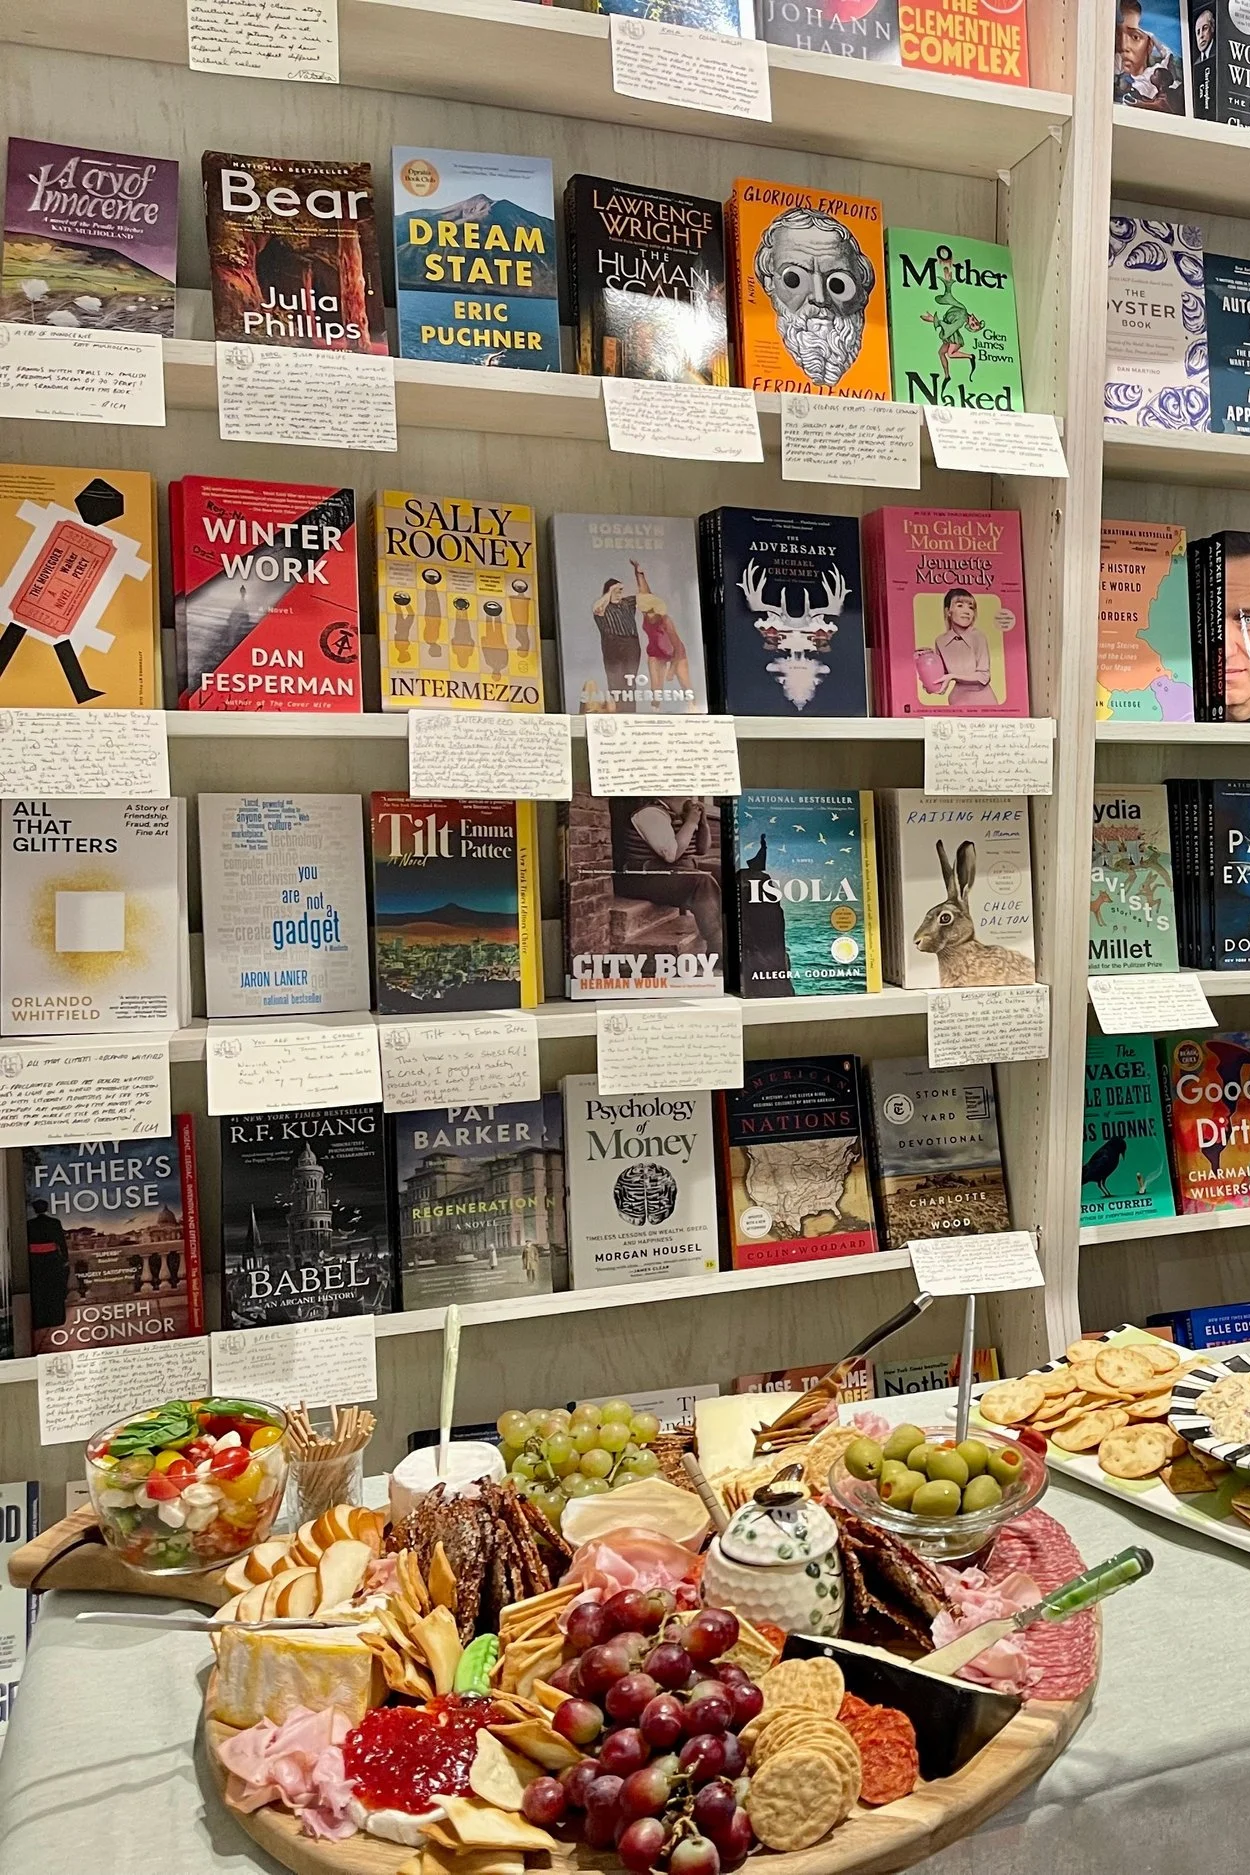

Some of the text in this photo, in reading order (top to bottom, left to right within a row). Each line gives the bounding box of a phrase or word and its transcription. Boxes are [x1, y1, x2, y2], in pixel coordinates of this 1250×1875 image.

[900, 33, 1021, 77] COMPLEX
[1228, 97, 1246, 108] THE
[57, 157, 80, 190] A
[123, 164, 156, 200] of
[233, 161, 348, 175] NATIONAL BESTSELLER
[27, 163, 159, 224] Innocence
[221, 169, 367, 219] Bear
[593, 190, 713, 230] LAWRENCE
[51, 225, 133, 240] KATE MULHOLLAND
[408, 218, 545, 254] DREAM
[425, 254, 532, 287] STATE
[598, 249, 709, 290] HUMAN
[899, 245, 1008, 290] Mother
[261, 287, 338, 312] Julia
[244, 312, 361, 345] Phillips
[1122, 319, 1151, 329] BOOK
[405, 498, 513, 537] SALLY
[202, 517, 344, 552] WINTER
[588, 523, 664, 537] ROSALYN
[904, 519, 1004, 540] I'm Glad My
[385, 527, 532, 569] ROONEY
[749, 541, 837, 557] ADVERSARY
[910, 535, 997, 552] Mom Died
[221, 553, 330, 585] WORK
[768, 566, 820, 578] CRUMMEY
[917, 555, 993, 571] Jennette
[1107, 564, 1147, 575] HISTORY
[915, 569, 995, 590] McCurdy
[1105, 597, 1113, 605] in
[251, 647, 304, 668] DAN
[201, 672, 354, 697] FESPERMAN
[390, 677, 540, 704] INTERMEZZO
[624, 674, 648, 687] TO
[13, 801, 52, 817] ALL
[135, 805, 158, 813] Story
[748, 795, 853, 804] NATIONAL BESTSELLER
[13, 838, 118, 853] GLITTERS
[378, 812, 454, 858] Tilt
[298, 866, 318, 883] you
[748, 878, 858, 904] ISOLA
[326, 905, 332, 918] a
[983, 900, 1022, 912] CHLOE
[273, 911, 341, 950] gadget
[980, 915, 1030, 927] DALTON
[235, 923, 271, 943] create
[240, 970, 308, 989] JARON LANIER
[751, 968, 860, 980] ALLEGRA GOODMAN
[11, 996, 92, 1008] ORLANDO
[12, 1010, 100, 1021] WHITFIELD
[916, 1088, 957, 1099] STONE
[1106, 1084, 1152, 1106] DEATH
[585, 1098, 696, 1124] Psychology
[741, 1112, 850, 1134] NATIONS
[1196, 1117, 1249, 1148] Dirt
[414, 1123, 531, 1150] BARKER
[586, 1129, 698, 1163] Money
[899, 1134, 983, 1149] DEVOTIONAL
[35, 1155, 172, 1187] FATHER'S
[51, 1184, 159, 1214] HOUSE
[909, 1191, 987, 1208] CHARLOTTE
[463, 1220, 498, 1229] NOVEL
[747, 1239, 866, 1260] COLIN WOODARD
[249, 1259, 370, 1299] BABEL
[73, 1301, 150, 1325] JOSEPH
[51, 1318, 175, 1345] O'CONNOR
